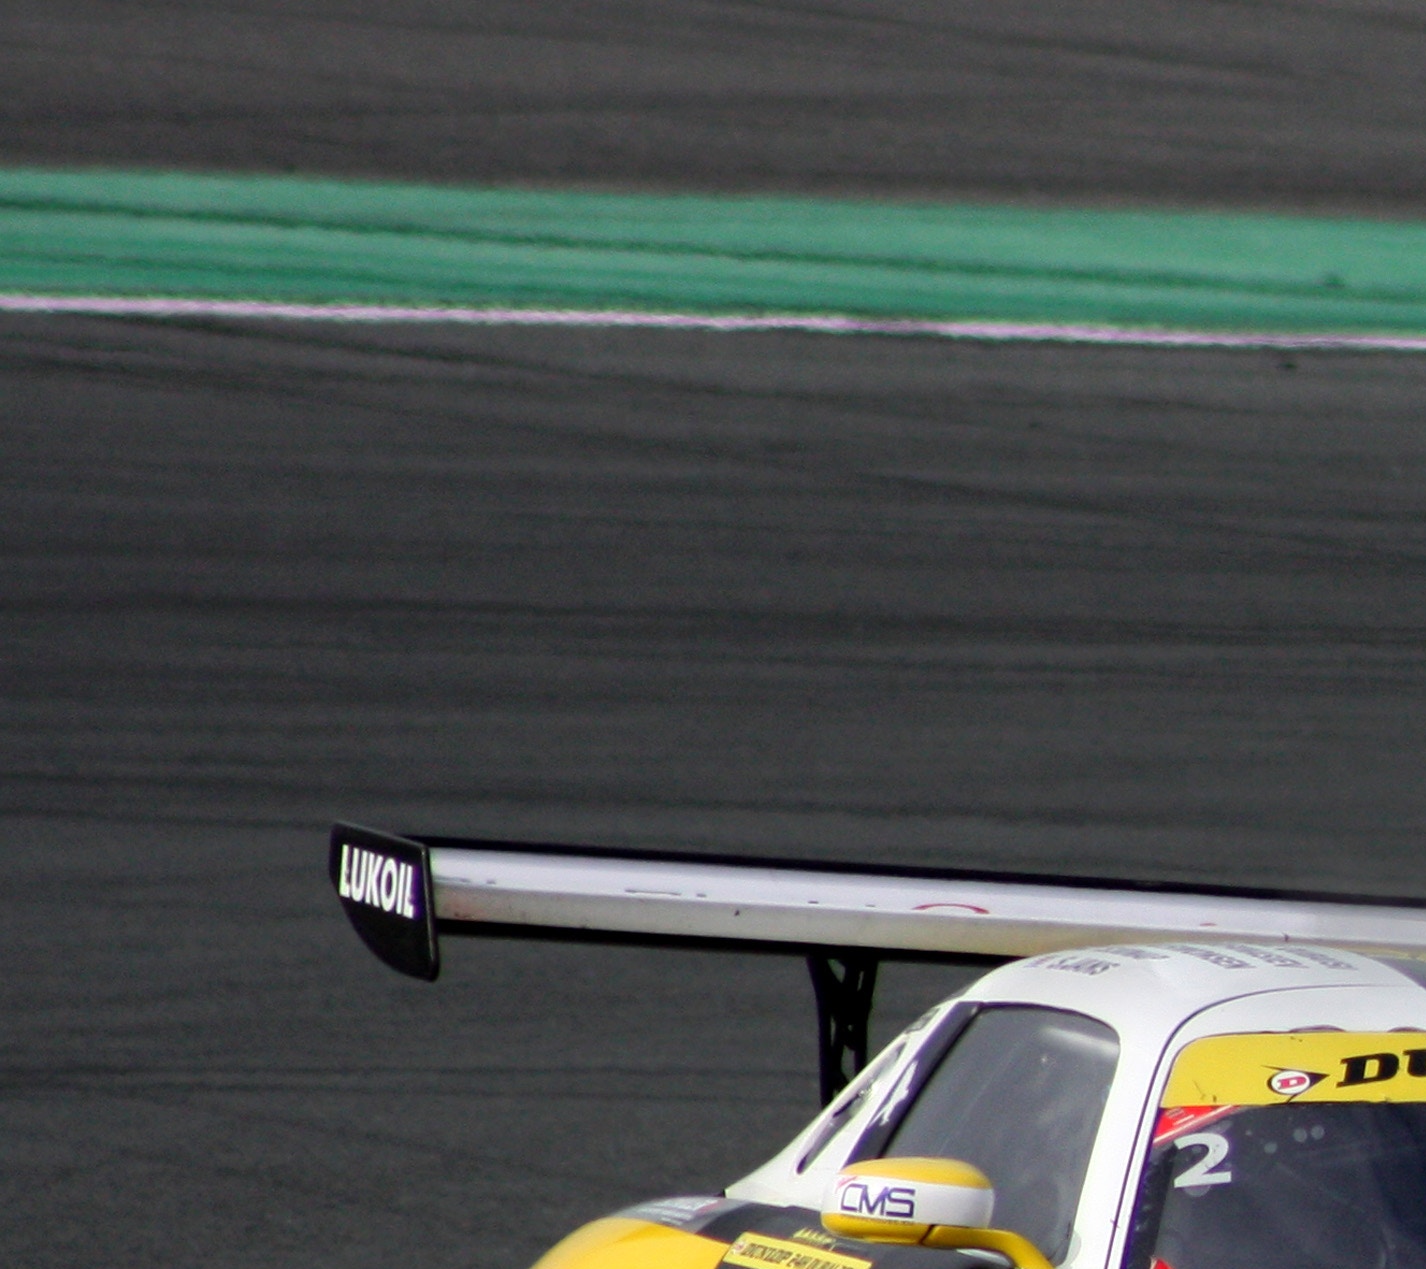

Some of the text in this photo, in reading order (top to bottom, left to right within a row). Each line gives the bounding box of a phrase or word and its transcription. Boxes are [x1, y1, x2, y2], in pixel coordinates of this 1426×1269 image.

[339, 844, 414, 919] LUKOIL
[1173, 1132, 1232, 1188] 2
[841, 1183, 916, 1219] CMS
